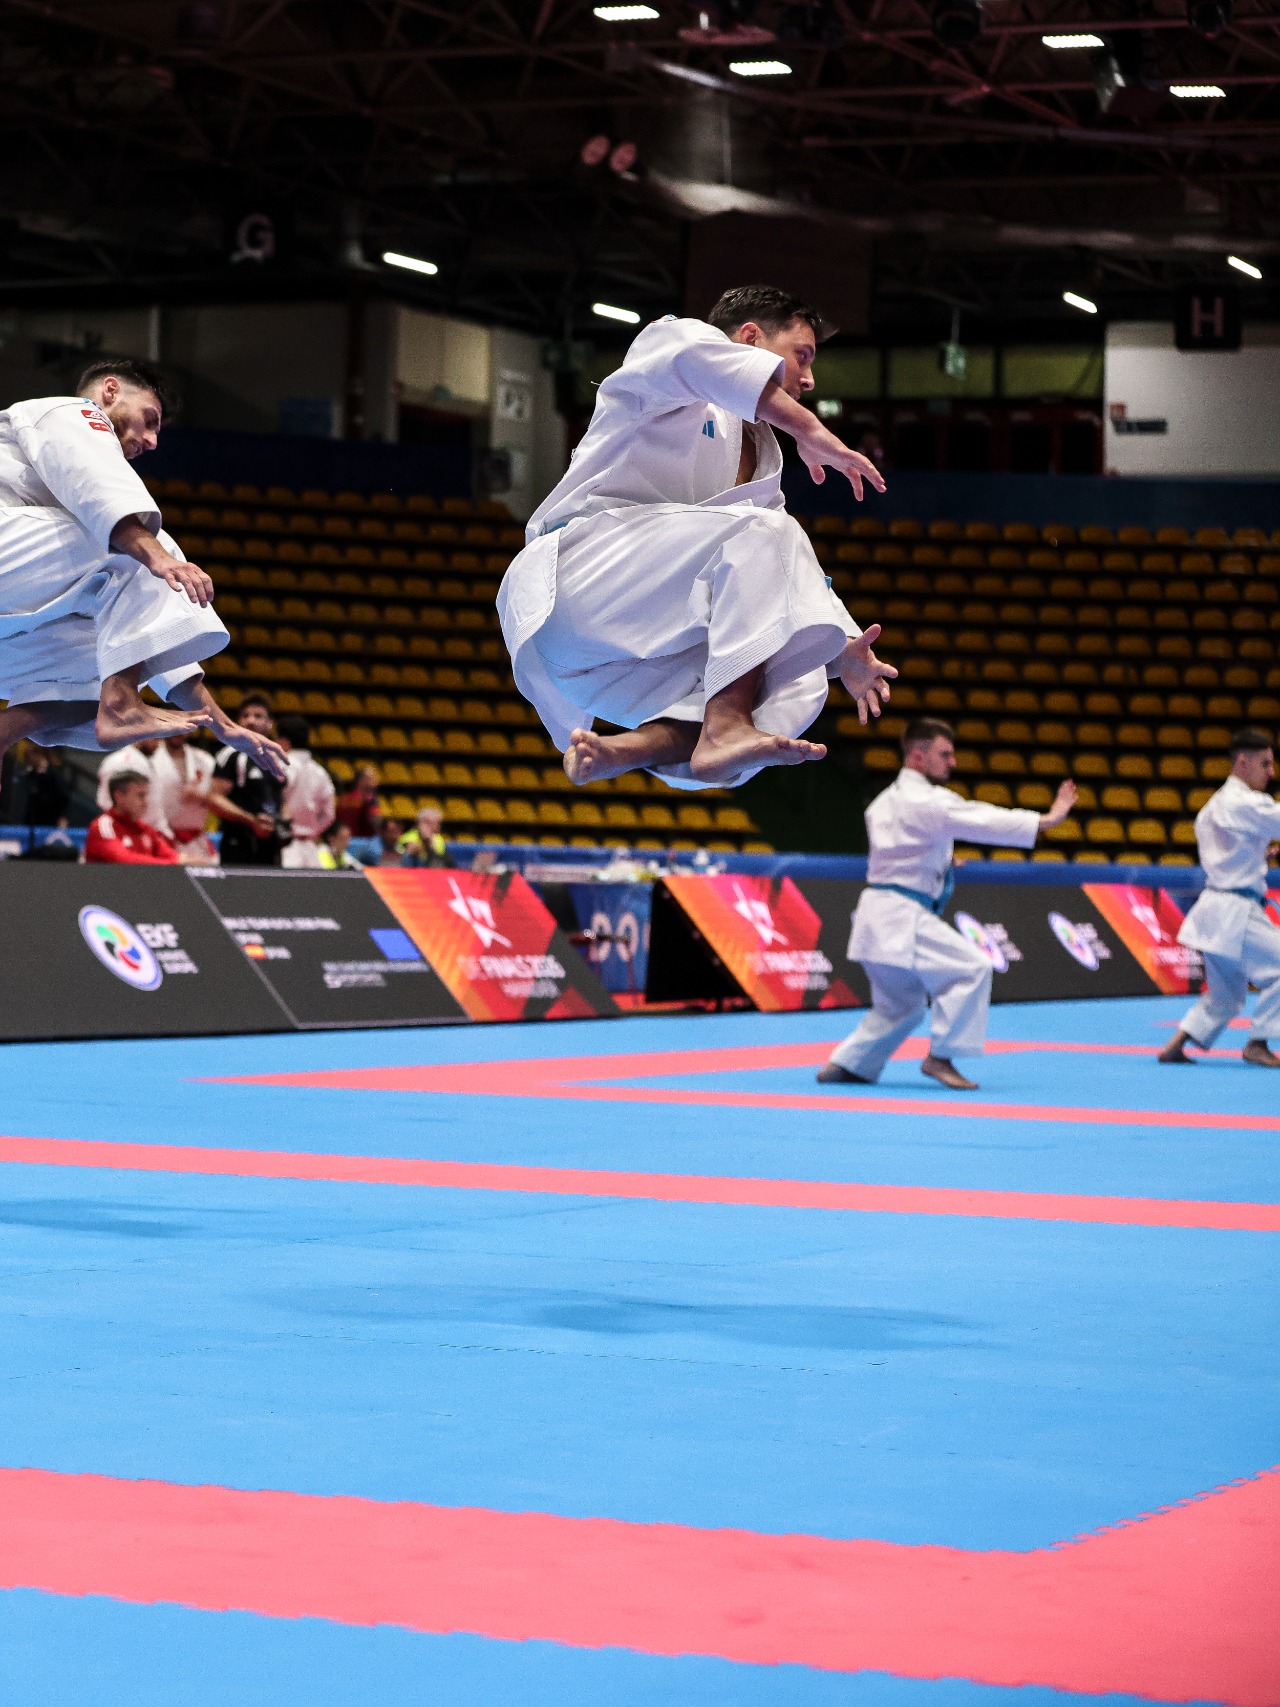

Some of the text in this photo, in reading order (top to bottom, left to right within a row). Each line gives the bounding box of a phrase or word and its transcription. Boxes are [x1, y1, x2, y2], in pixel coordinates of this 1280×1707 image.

[237, 213, 276, 259] G
[1191, 296, 1224, 338] H
[135, 922, 179, 949] EKF
